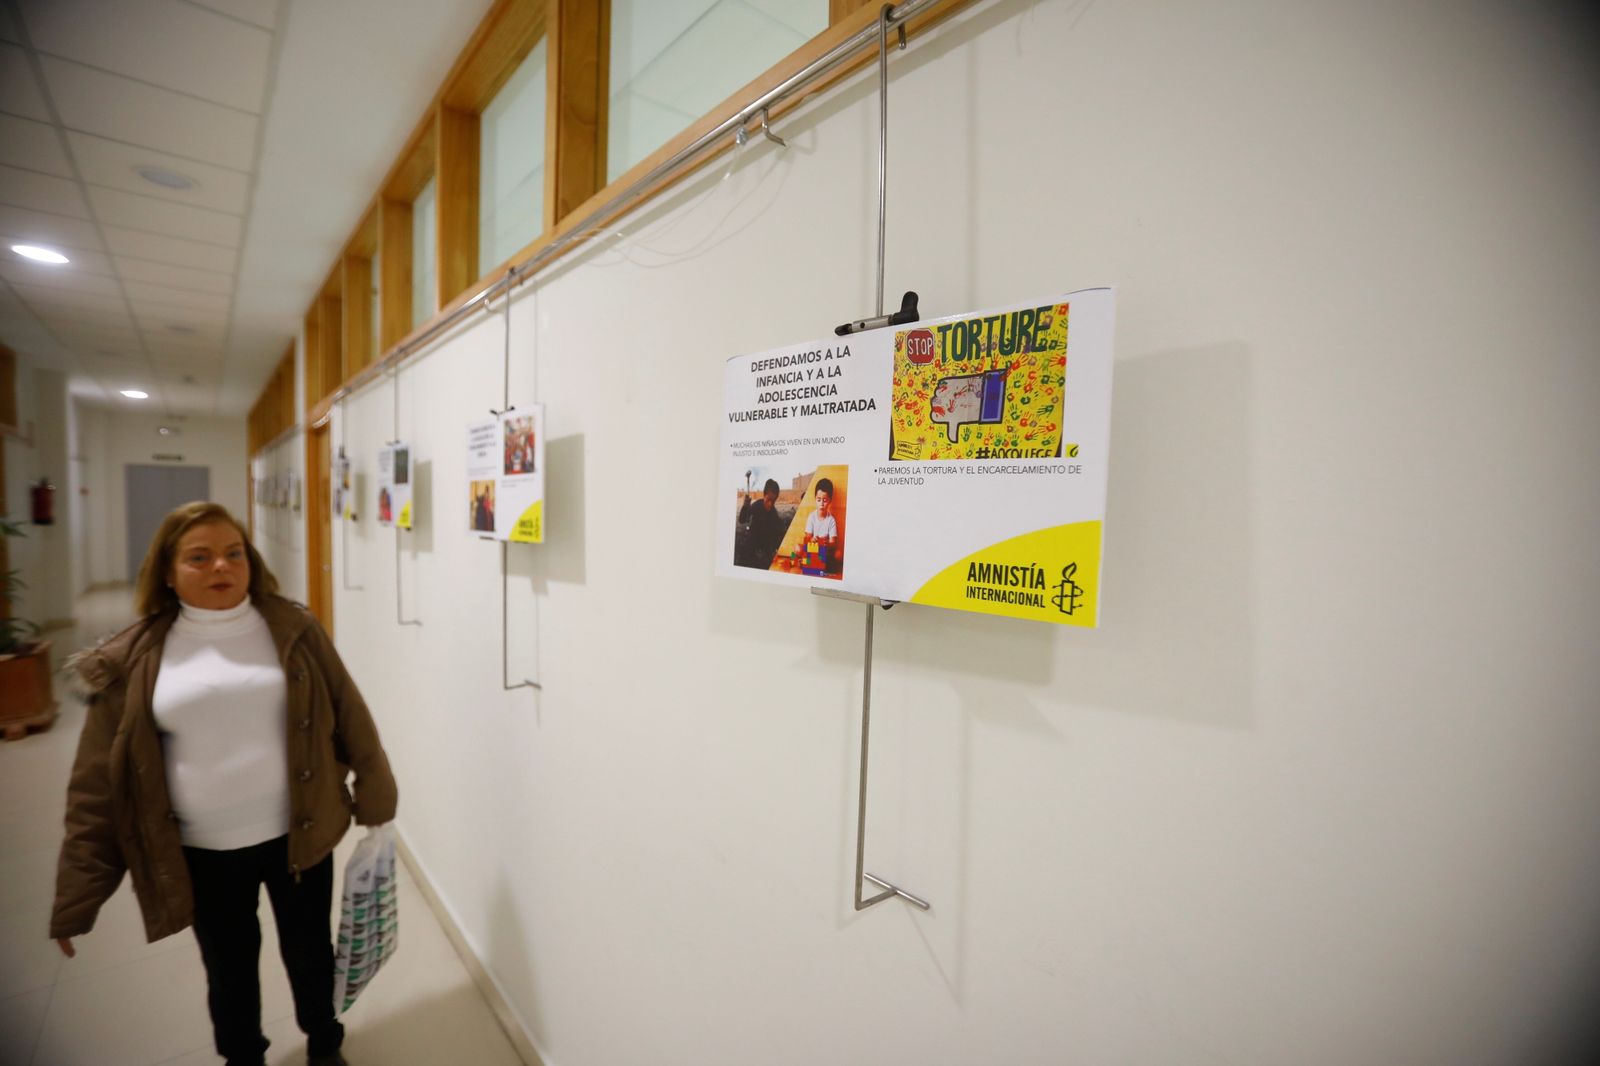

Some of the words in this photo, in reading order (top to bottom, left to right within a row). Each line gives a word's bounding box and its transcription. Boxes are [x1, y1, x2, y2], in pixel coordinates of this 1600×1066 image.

[908, 336, 933, 356] STOP
[937, 304, 1054, 363] TORTURE
[751, 350, 822, 373] DEFENDAMOS
[824, 348, 834, 361] A
[836, 345, 851, 359] LA
[756, 370, 804, 388] INFANCIA
[806, 369, 814, 381] Y
[816, 368, 825, 380] A
[827, 365, 842, 378] LA
[757, 383, 838, 404] ADOLESCENCIA
[728, 407, 788, 423] VULNERABLE
[791, 406, 798, 417] Y
[800, 398, 876, 417] MALTRATADA
[786, 438, 802, 446] VIVEN
[803, 438, 811, 446] EN
[811, 437, 821, 445] UN
[821, 436, 846, 445] MUNDO
[877, 477, 887, 485] LA
[887, 477, 925, 486] JUVENTUD
[878, 466, 911, 475] PAREMOS
[912, 466, 921, 475] LA
[922, 466, 958, 475] TORTURA
[959, 466, 965, 475] Y
[966, 466, 975, 475] EL
[977, 465, 1066, 475] ENCARCELAMIENTO
[1068, 465, 1082, 474] DE
[967, 562, 1046, 590] AMNISTÍA
[966, 585, 1046, 608] INTERNACIONAL
